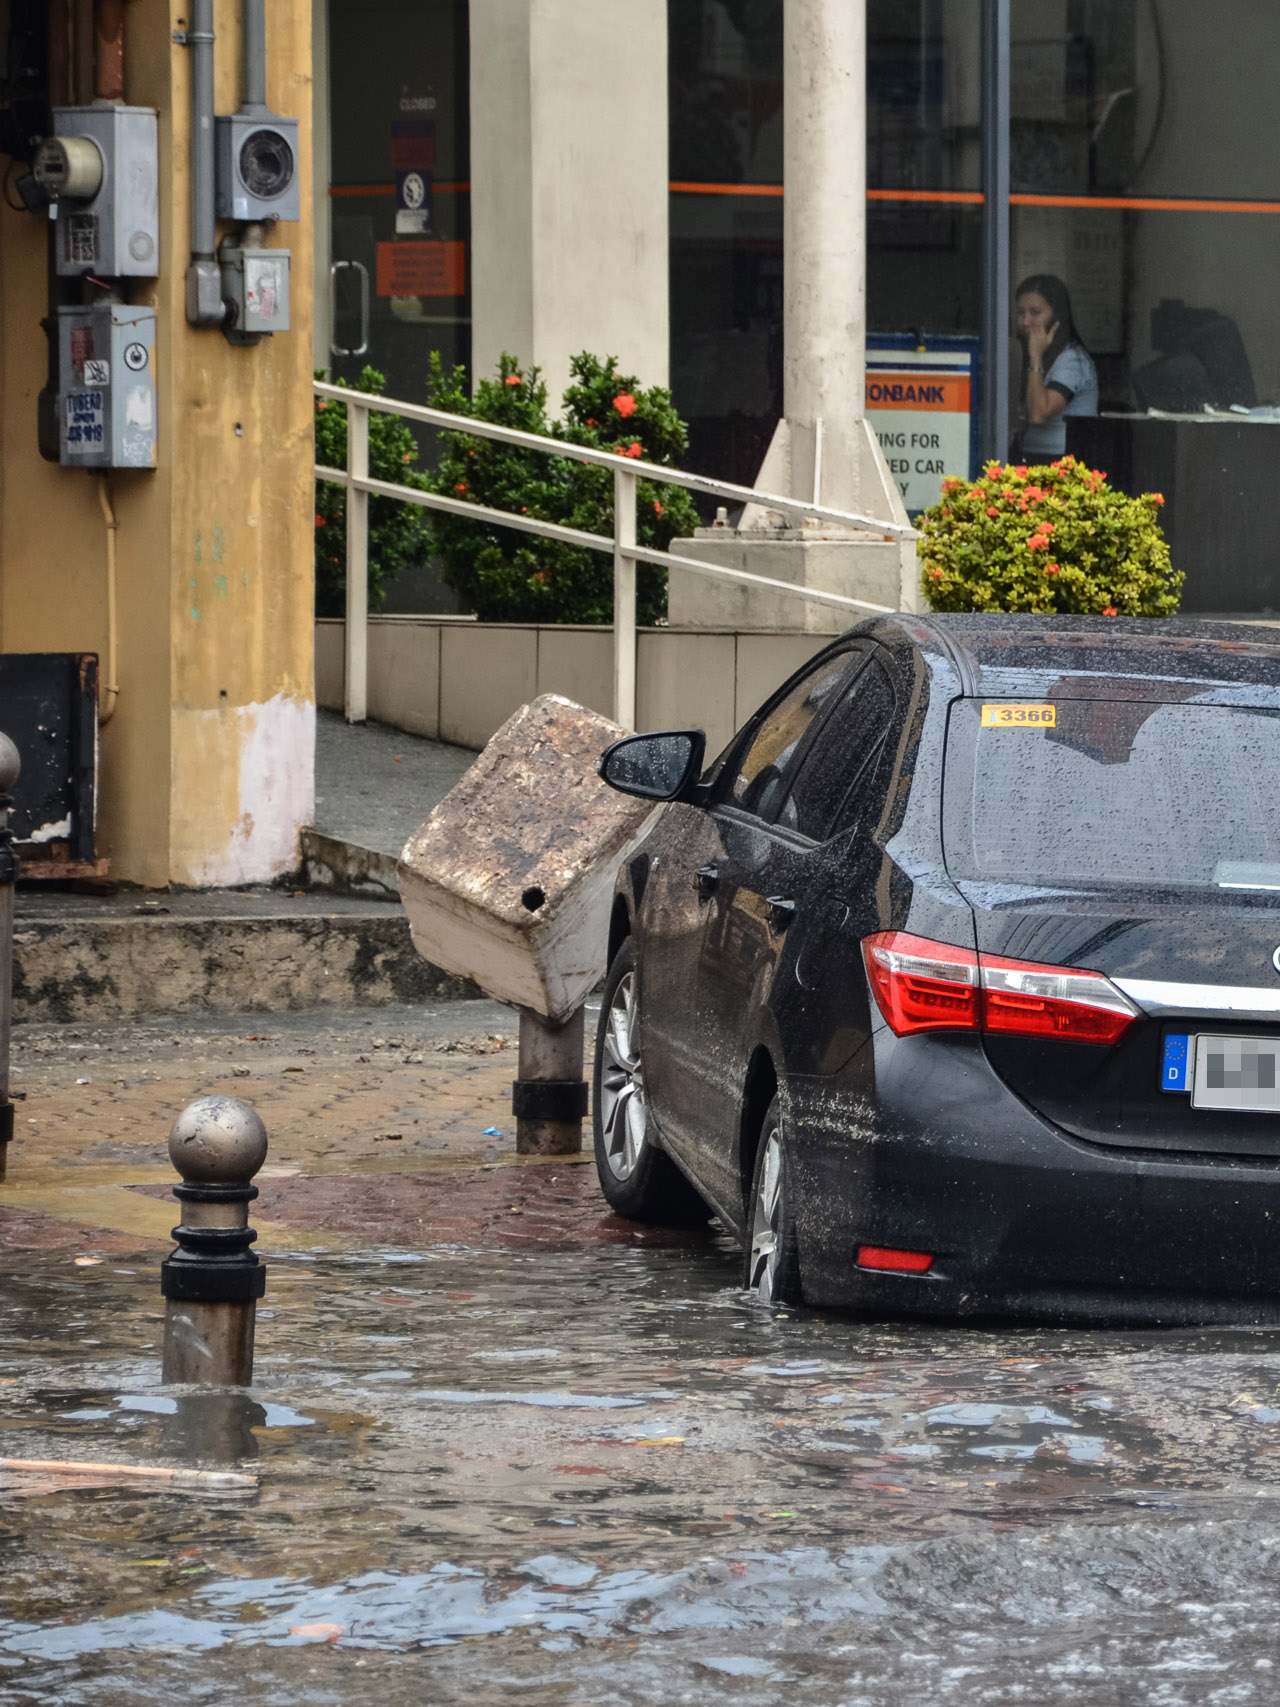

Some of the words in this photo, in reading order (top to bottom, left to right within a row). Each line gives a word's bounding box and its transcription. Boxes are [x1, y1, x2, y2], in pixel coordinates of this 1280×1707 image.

[400, 96, 437, 111] CLOSED
[875, 432, 906, 449] ING
[911, 433, 940, 449] FOR
[886, 459, 910, 474] ED
[915, 459, 944, 475] CAR
[1001, 709, 1054, 722] 3366
[1167, 1067, 1179, 1080] D
